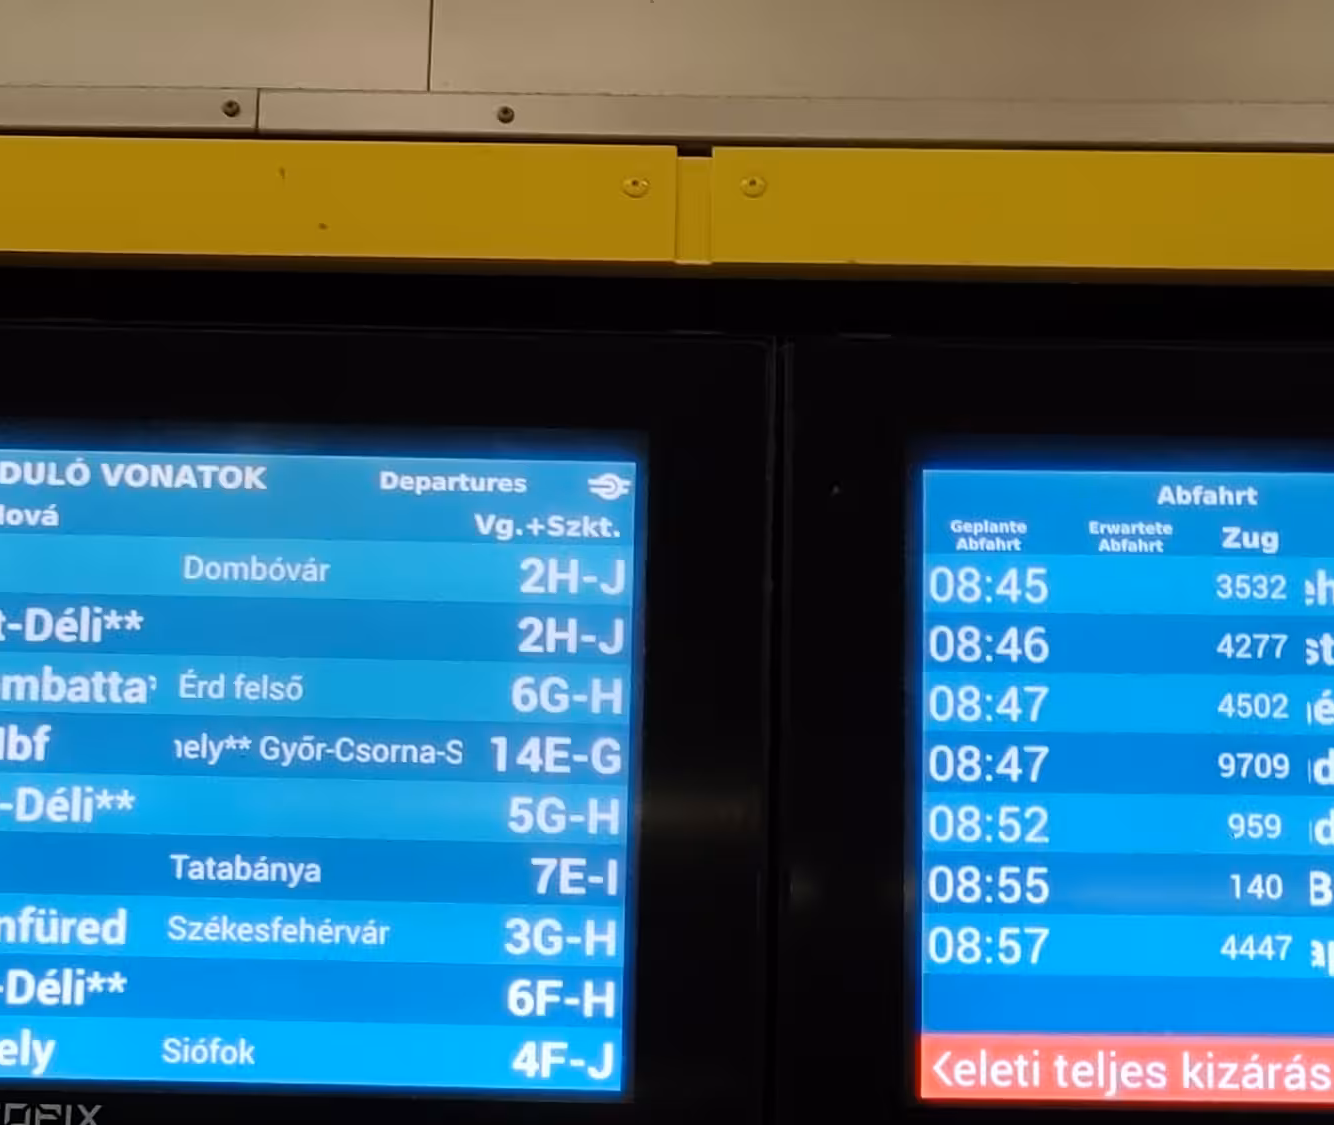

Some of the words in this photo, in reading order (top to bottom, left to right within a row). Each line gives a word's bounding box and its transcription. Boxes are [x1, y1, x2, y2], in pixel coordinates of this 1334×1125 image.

[100, 463, 267, 489] VONATOK
[379, 471, 527, 495] Departures
[1158, 485, 1258, 506] Abfahrt
[474, 513, 620, 540] Vg.+Szkt.
[950, 520, 1027, 537] Geplante
[956, 537, 1022, 552] Abfahrt
[1088, 520, 1173, 536] Erwartete
[1098, 538, 1164, 553] Abfahrt
[1222, 527, 1279, 554] Zug
[183, 555, 330, 582] Dombóvár
[519, 557, 625, 595] 2H-J
[929, 566, 1048, 604] 08:45
[1216, 575, 1287, 600] 3532
[517, 616, 624, 654] 2H-J
[929, 626, 1049, 664] 08:46
[1217, 634, 1288, 660] 4277
[179, 668, 225, 700] Érd
[233, 673, 304, 702] felső
[510, 676, 623, 715] 6G-H
[928, 685, 1049, 723] 08:47
[1217, 693, 1289, 720] 4502
[259, 735, 463, 768] Győr-Csorna-S
[490, 735, 622, 775] 14E-G
[928, 745, 1049, 783] 08:47
[1217, 753, 1290, 780] 9709
[507, 796, 620, 835] 5G-H
[928, 805, 1049, 844] 08:52
[1228, 814, 1282, 840] 959
[169, 853, 322, 887] Tatabánya
[530, 858, 618, 895] 7E-I
[928, 865, 1049, 905] 08:55
[1230, 874, 1283, 900] 140
[167, 915, 390, 946] Székesfehérvár
[504, 918, 616, 957] 3G-H
[928, 926, 1049, 965] 08:57
[1220, 935, 1293, 962] 4447
[507, 978, 615, 1018] 6F-H
[161, 1037, 255, 1067] Siófok
[512, 1041, 614, 1080] 4F-J
[1054, 1050, 1167, 1098] teljes
